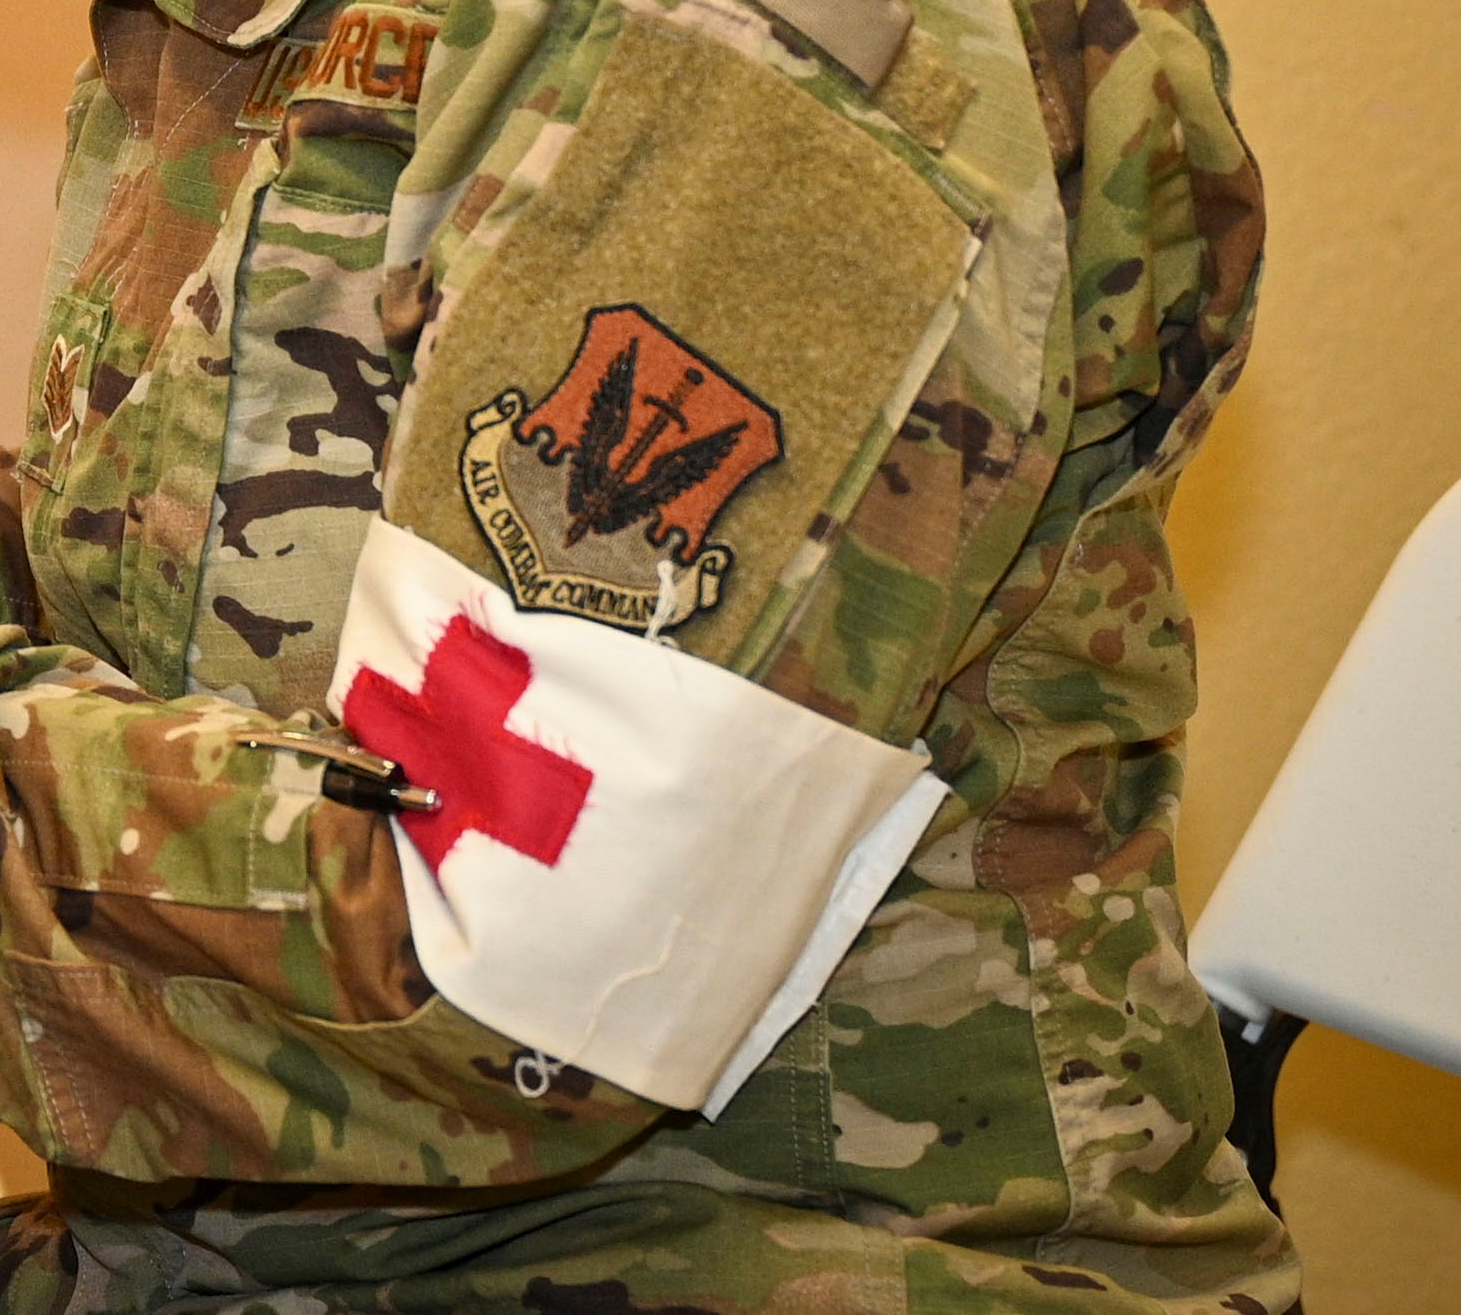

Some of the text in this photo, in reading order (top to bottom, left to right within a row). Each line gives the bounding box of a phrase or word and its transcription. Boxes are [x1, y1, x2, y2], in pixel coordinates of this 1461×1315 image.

[470, 459, 659, 622] AIR COMBAT COMMAN
